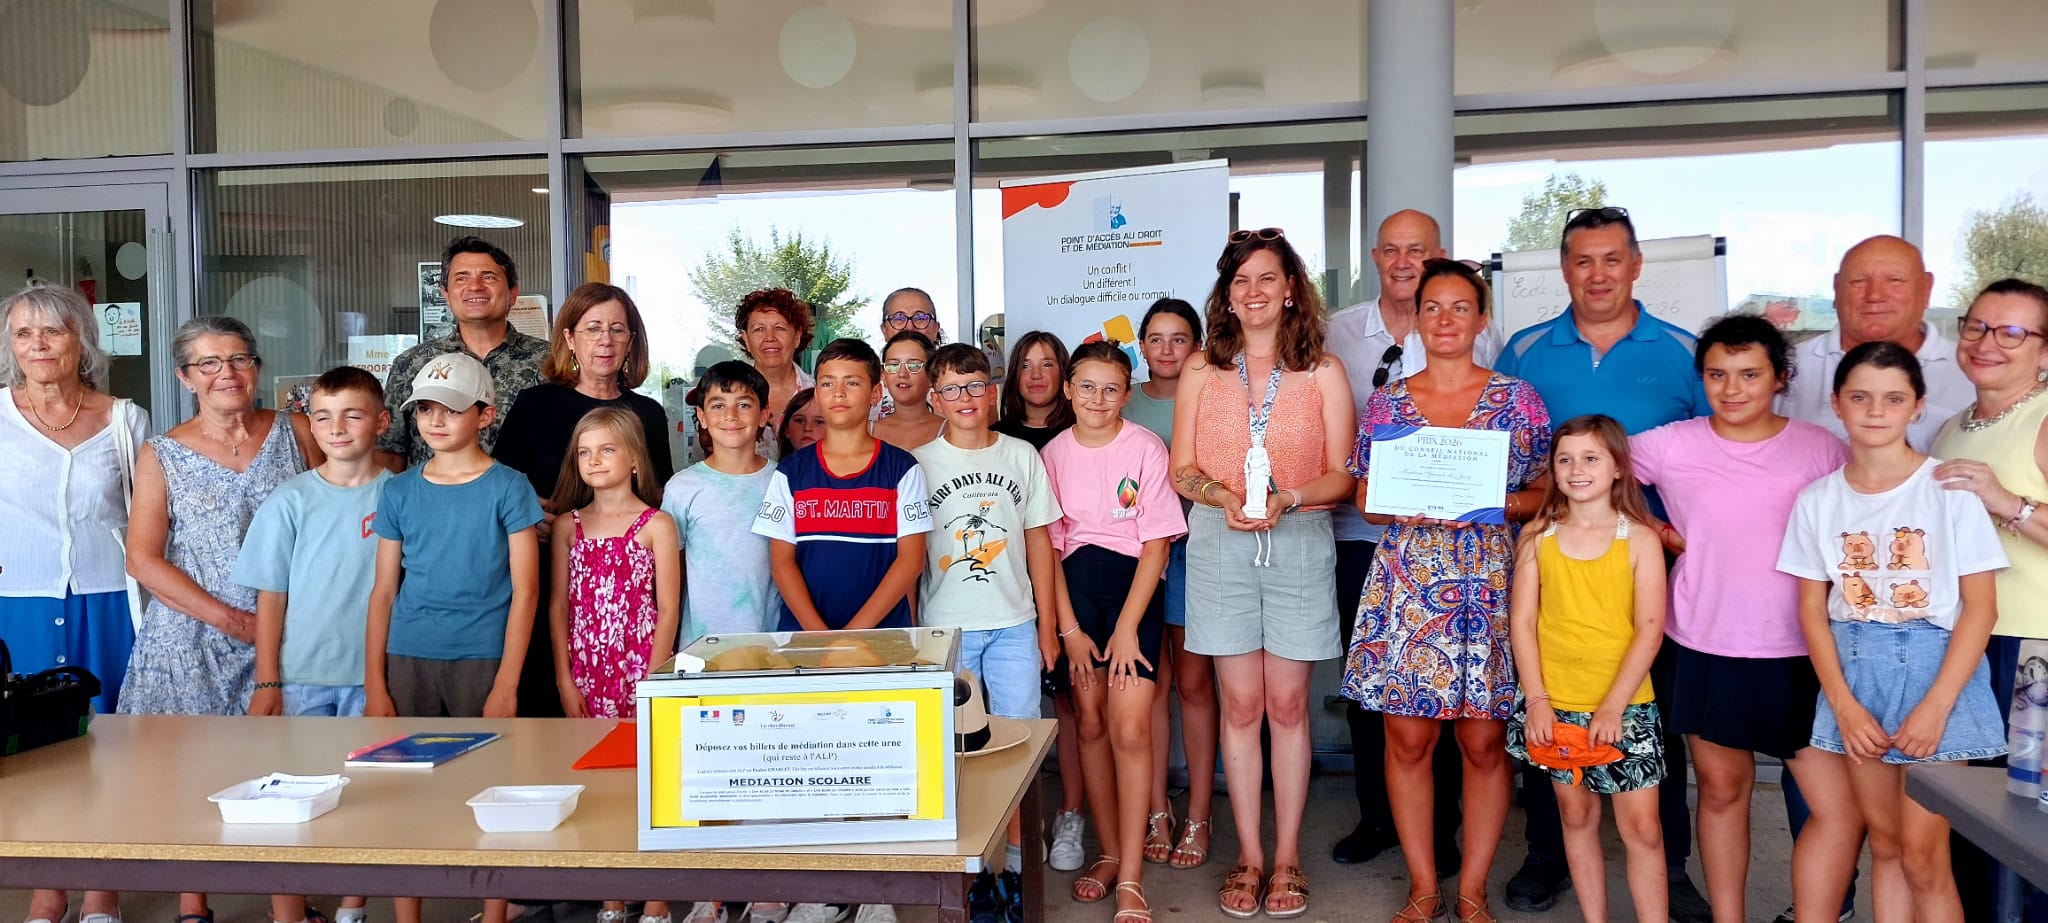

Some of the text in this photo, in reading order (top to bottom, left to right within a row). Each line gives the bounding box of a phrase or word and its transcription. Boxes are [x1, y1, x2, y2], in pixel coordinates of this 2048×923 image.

[1062, 236, 1084, 245] POINT
[1124, 232, 1135, 240] AU
[1137, 230, 1162, 239] DROIT
[1062, 245, 1070, 253] ET
[1073, 244, 1083, 252] DE
[1088, 265, 1099, 275] Un
[1101, 263, 1127, 275] conflit
[1083, 280, 1095, 289] Un
[1097, 278, 1131, 289] différent
[1047, 296, 1058, 305] Un
[1061, 293, 1095, 306] dialogue
[1097, 291, 1127, 303] difficile
[1129, 293, 1140, 301] ou
[1141, 290, 1169, 300] rompu
[1646, 300, 1680, 316] 026
[366, 350, 390, 359] Mme
[1417, 436, 1438, 446] PRIX
[1409, 446, 1444, 454] CONSEIL
[1447, 449, 1488, 457] NATIONAL
[929, 473, 1023, 510] SURF DAYS ALL YEAR
[962, 491, 999, 499] California
[759, 501, 786, 523] LO
[795, 499, 891, 519] ST. MARTIN
[695, 742, 731, 752] Déposez
[750, 742, 776, 750] billets
[778, 742, 789, 750] de
[791, 740, 833, 750] médiation
[836, 740, 856, 748] dans
[858, 739, 879, 748] cette
[763, 753, 780, 764] (qui
[810, 752, 838, 761] l'ALP)
[729, 776, 872, 787] MEDIATION SCOLAIRE
